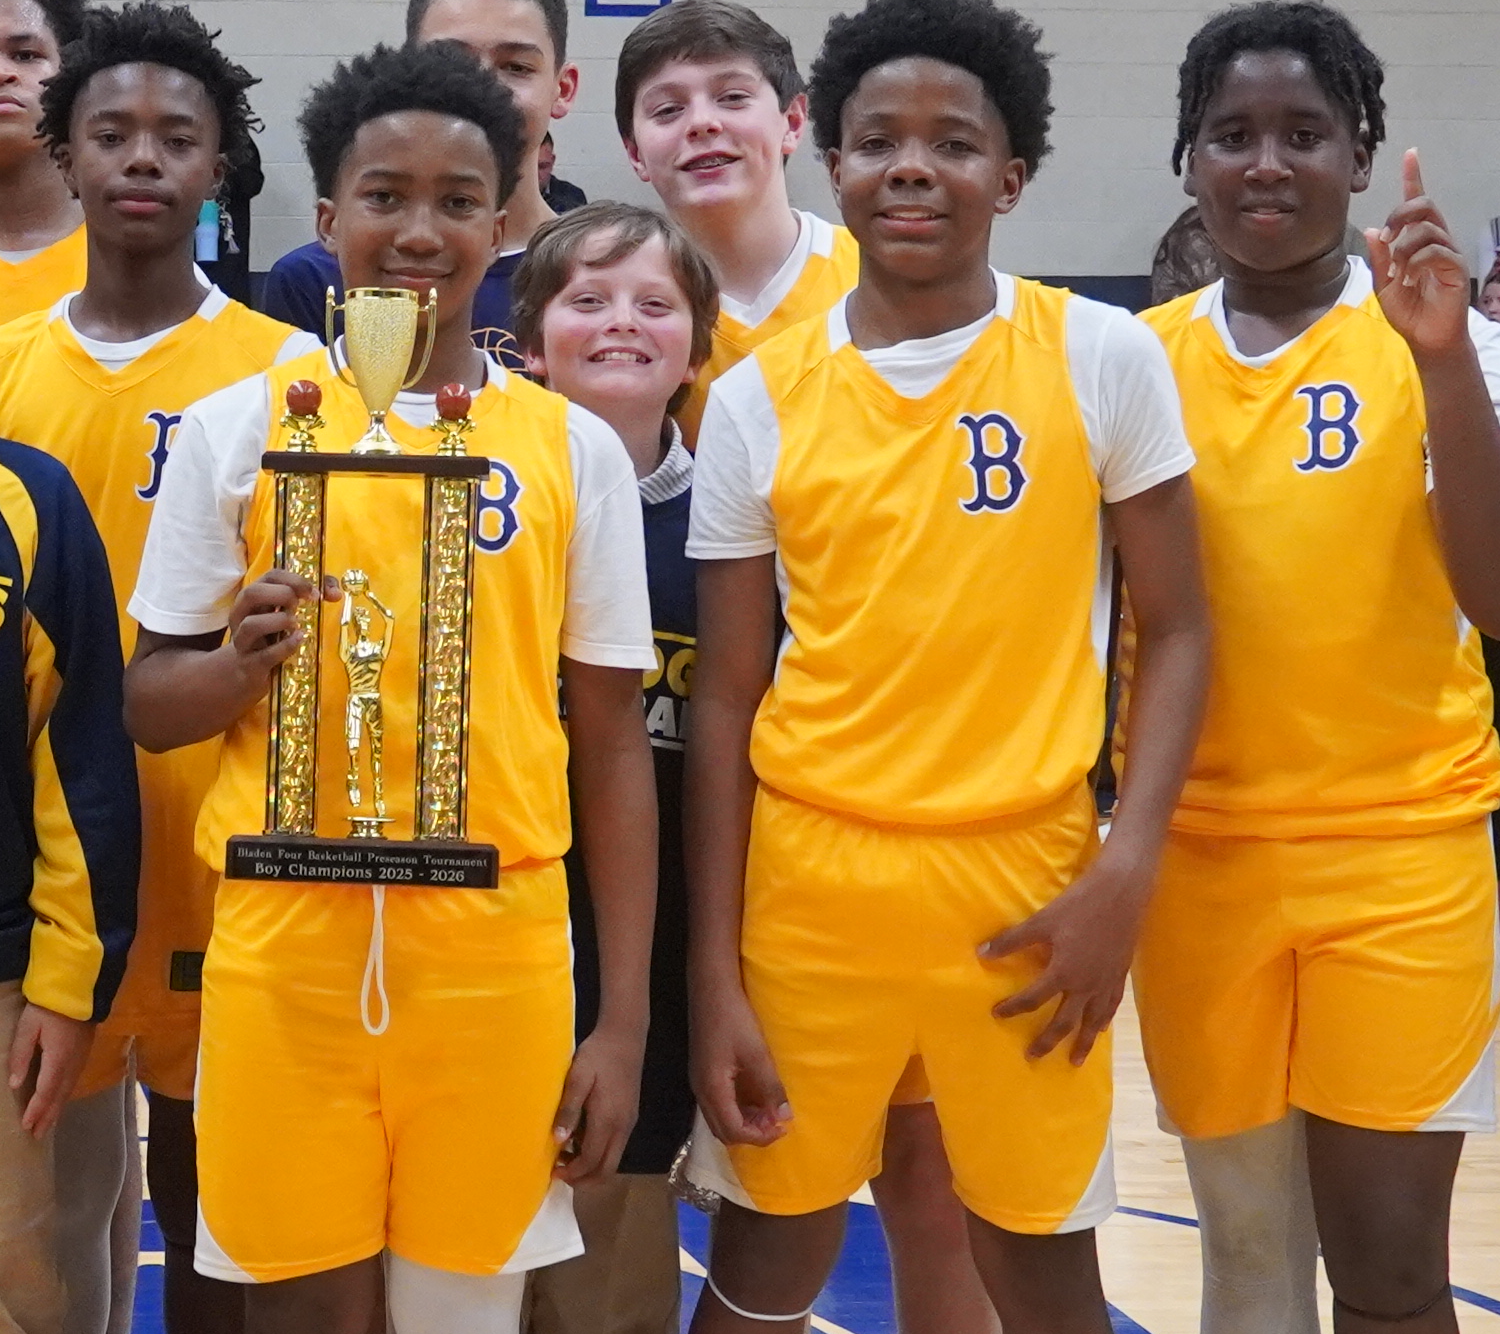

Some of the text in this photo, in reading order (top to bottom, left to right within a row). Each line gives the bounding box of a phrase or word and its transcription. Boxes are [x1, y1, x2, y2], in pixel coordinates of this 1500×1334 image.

[1293, 381, 1364, 473] B
[955, 410, 1030, 515] B
[237, 847, 487, 867] Bladen Four Basketball Preseason Tournament
[255, 862, 282, 877] Boy
[288, 864, 373, 880] Champions
[378, 867, 413, 880] 2025
[429, 870, 465, 882] 2026
